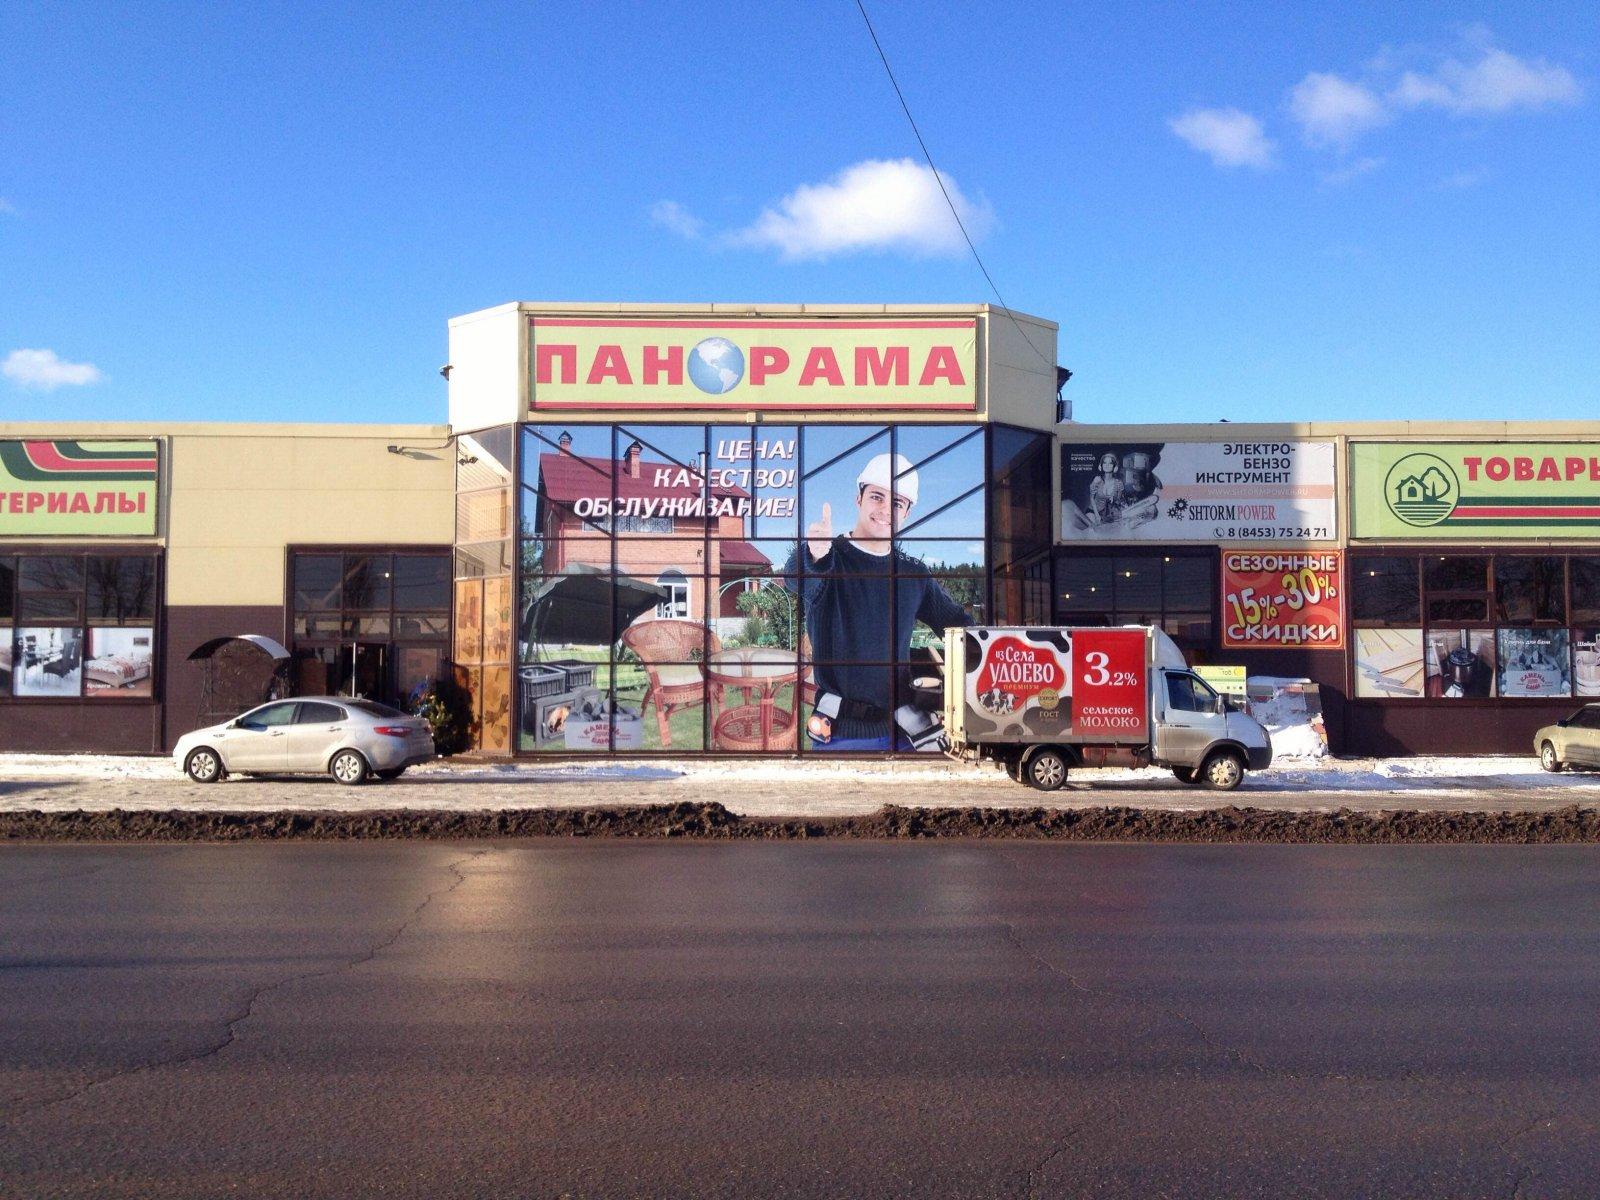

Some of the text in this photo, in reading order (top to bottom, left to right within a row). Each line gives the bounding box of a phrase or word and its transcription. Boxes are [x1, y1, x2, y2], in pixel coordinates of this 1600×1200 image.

[717, 440, 795, 463] ЦЕНА!
[1223, 443, 1296, 455] ЭЛЕКТРО-
[1243, 458, 1291, 469] БЕНЗО
[653, 468, 795, 488] КАЧЕСТВО!
[1195, 472, 1291, 483] ИНСТРУМЕНТ
[573, 497, 795, 518] ОБСЛУЖИВАНИЕ!
[1189, 505, 1276, 520] SHTORM POWER
[1228, 528, 1327, 538] 8 (8453) 75 24 71
[1227, 555, 1336, 571] СЕЗОННЫЕ
[1227, 624, 1337, 644] СКИДКИ
[1006, 647, 1035, 662] Села
[990, 663, 1054, 687] УДОЕВО
[1082, 707, 1134, 715] сельское
[1080, 717, 1140, 727] МОЛОКО
